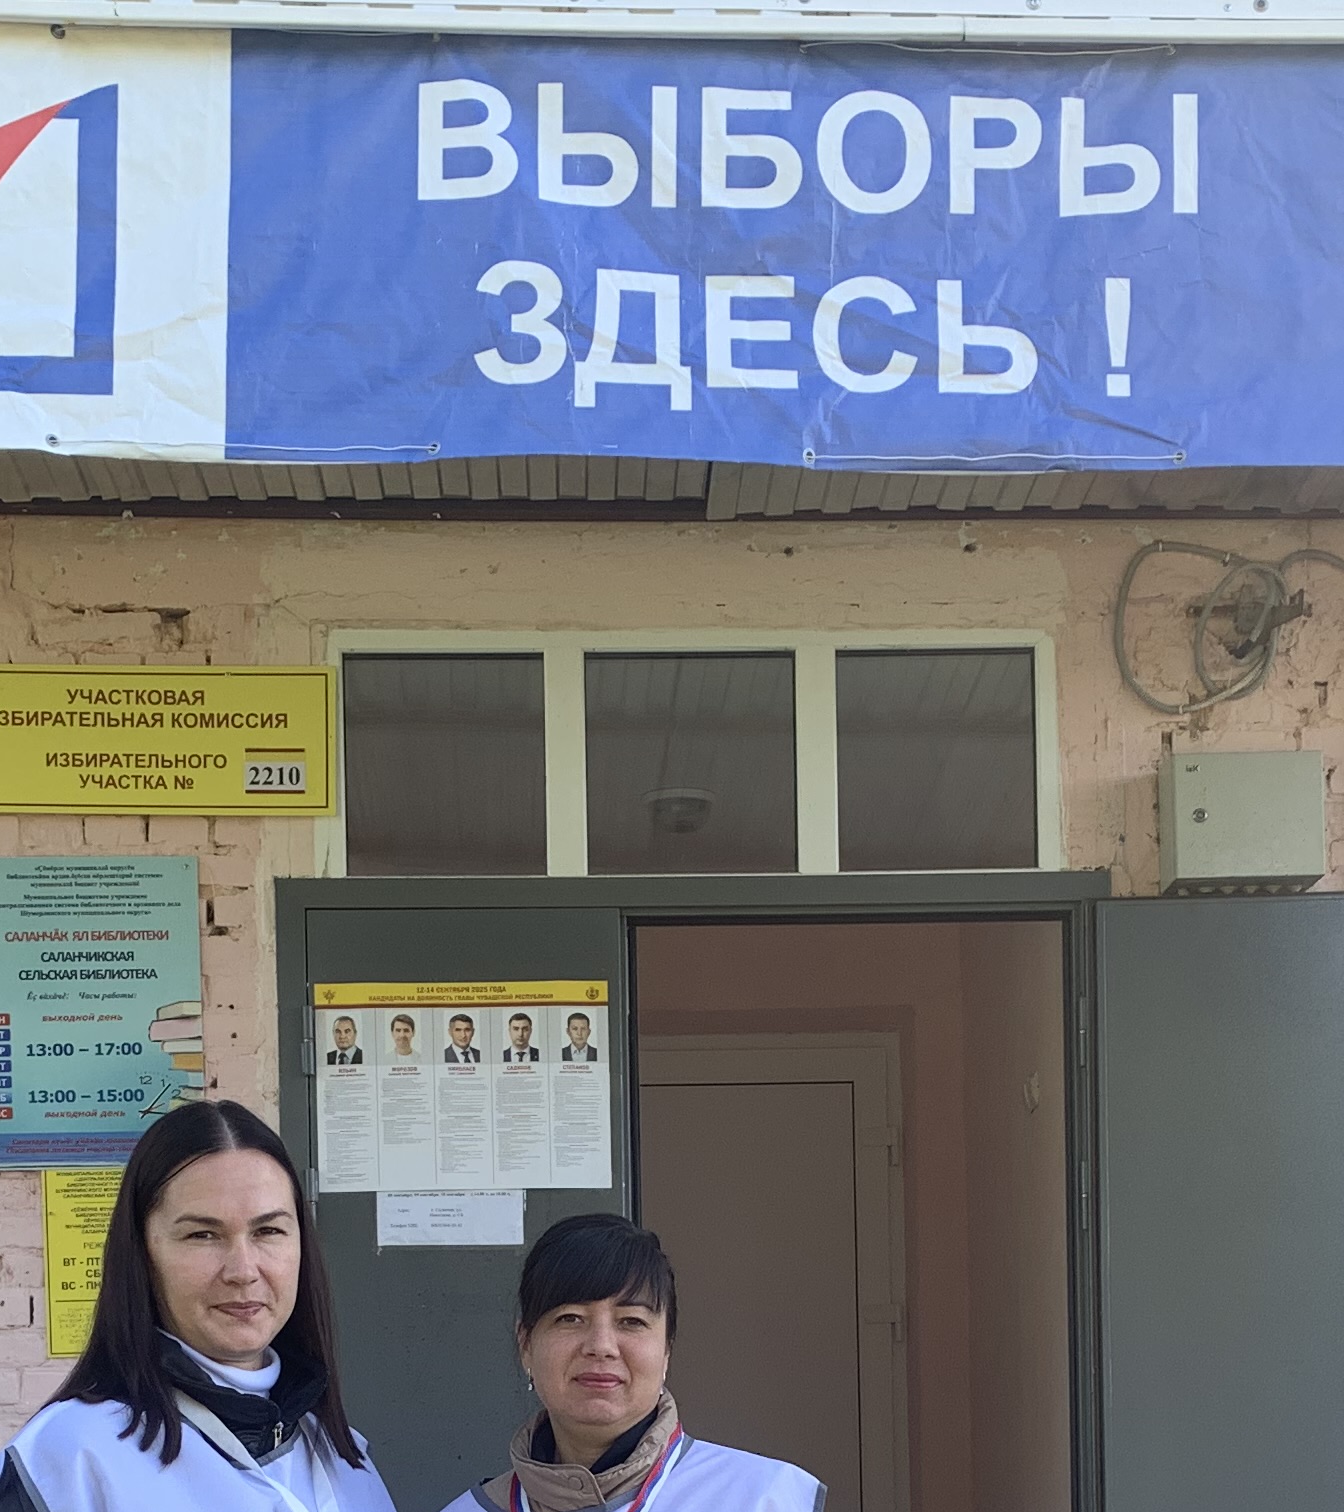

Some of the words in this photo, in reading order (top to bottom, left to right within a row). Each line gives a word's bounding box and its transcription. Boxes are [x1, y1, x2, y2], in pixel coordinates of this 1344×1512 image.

[418, 79, 1199, 217] ВЫБОРЫ
[474, 260, 1038, 411] ЗДЕСЬ
[1106, 278, 1131, 397] !
[66, 689, 206, 706] УЧАСТКОВАЯ
[171, 713, 289, 730] КОМИССИЯ
[45, 753, 228, 770] ИЗБИРАТЕЛЬНОГО
[79, 774, 168, 791] УЧАСТКА
[173, 775, 195, 790] №
[248, 766, 301, 787] 2210
[72, 931, 90, 941] ЯЛ
[91, 929, 169, 941] БИБЛИОТЕКИ
[40, 951, 134, 962] САЛАНЧИКСКАЯ
[18, 969, 78, 981] СЕЛЬСКАЯ
[79, 968, 158, 981] БИБЛИОТЕКА
[78, 992, 101, 1000] Часы
[101, 992, 137, 1001] работы:
[42, 1012, 96, 1022] выходной
[97, 1013, 123, 1022] день
[26, 1043, 74, 1057] 13:00
[94, 1042, 143, 1056] 17:00
[139, 1075, 152, 1085] 12
[28, 1090, 76, 1103] 13:00
[96, 1089, 145, 1103] 15:00
[99, 1110, 126, 1118] день
[63, 1258, 77, 1267] ВТ
[86, 1257, 101, 1266] ПТ
[85, 1269, 102, 1278] СБ
[61, 1282, 76, 1290] ВС
